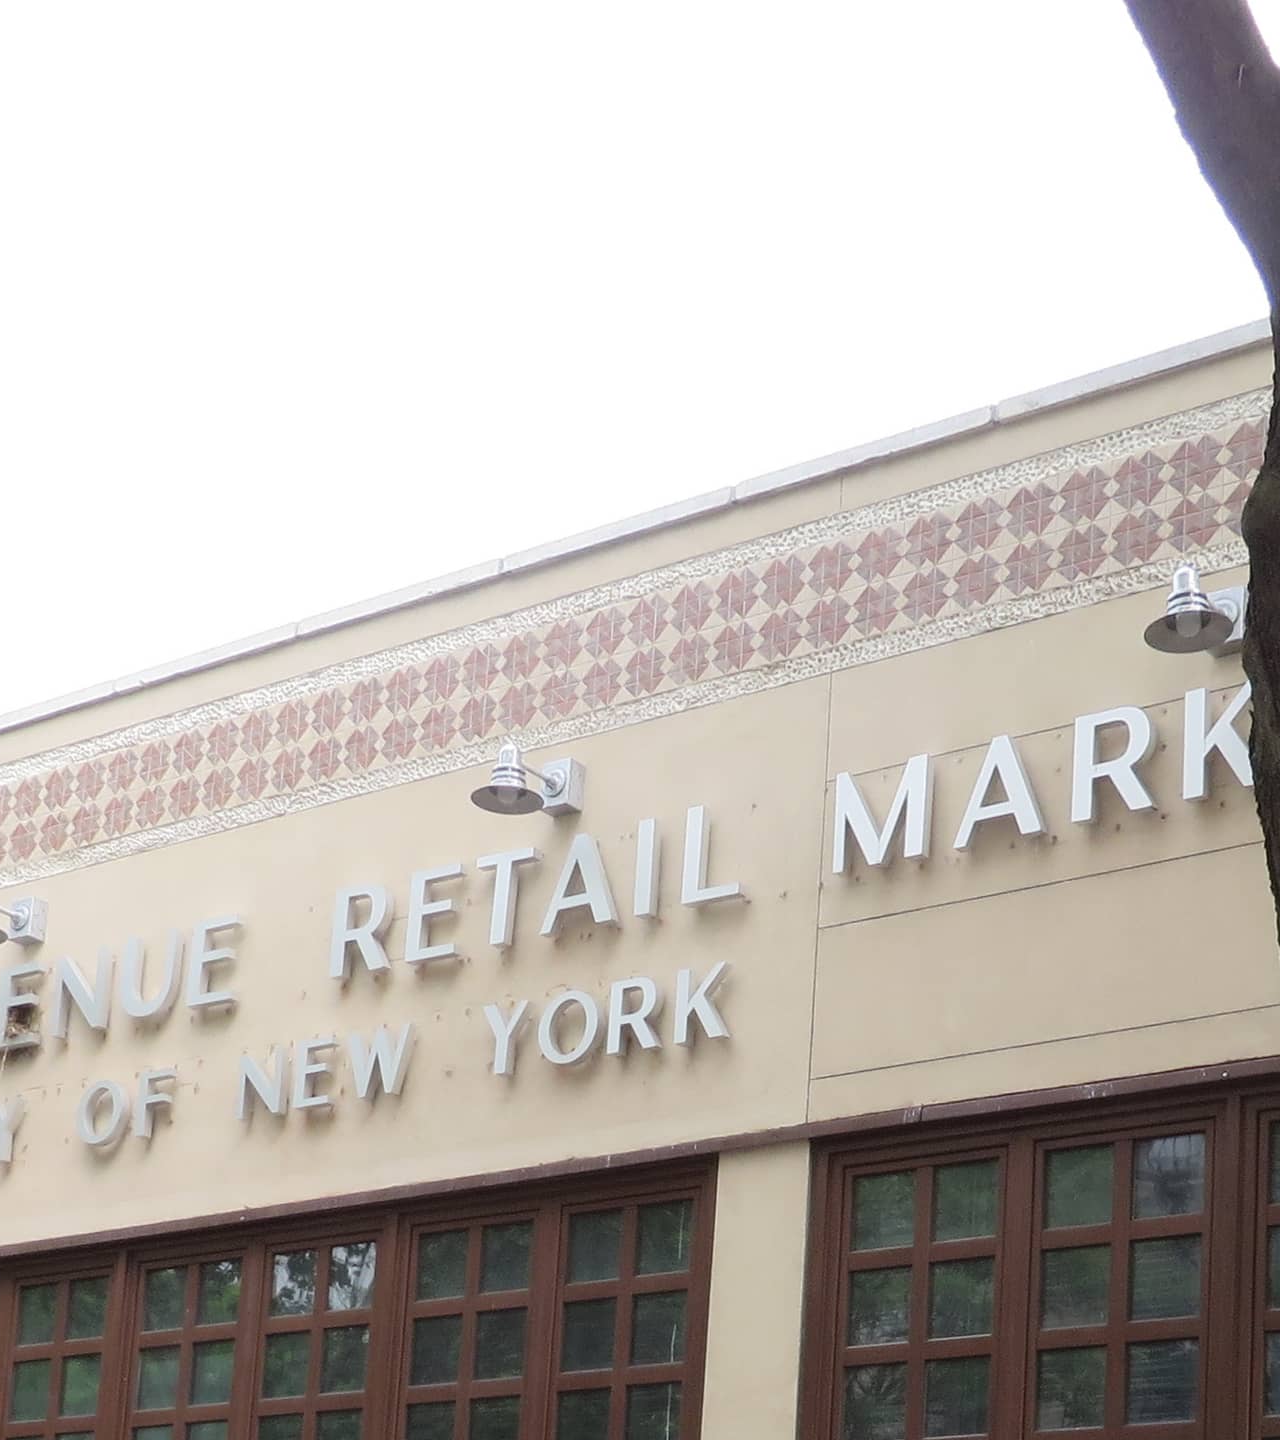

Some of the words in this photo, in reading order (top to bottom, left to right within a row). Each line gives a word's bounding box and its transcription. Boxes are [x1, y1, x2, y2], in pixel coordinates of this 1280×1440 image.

[329, 805, 743, 982] RETAIL
[77, 1067, 177, 1146] OF
[235, 1022, 416, 1120] NEW
[482, 961, 732, 1077] YORK
